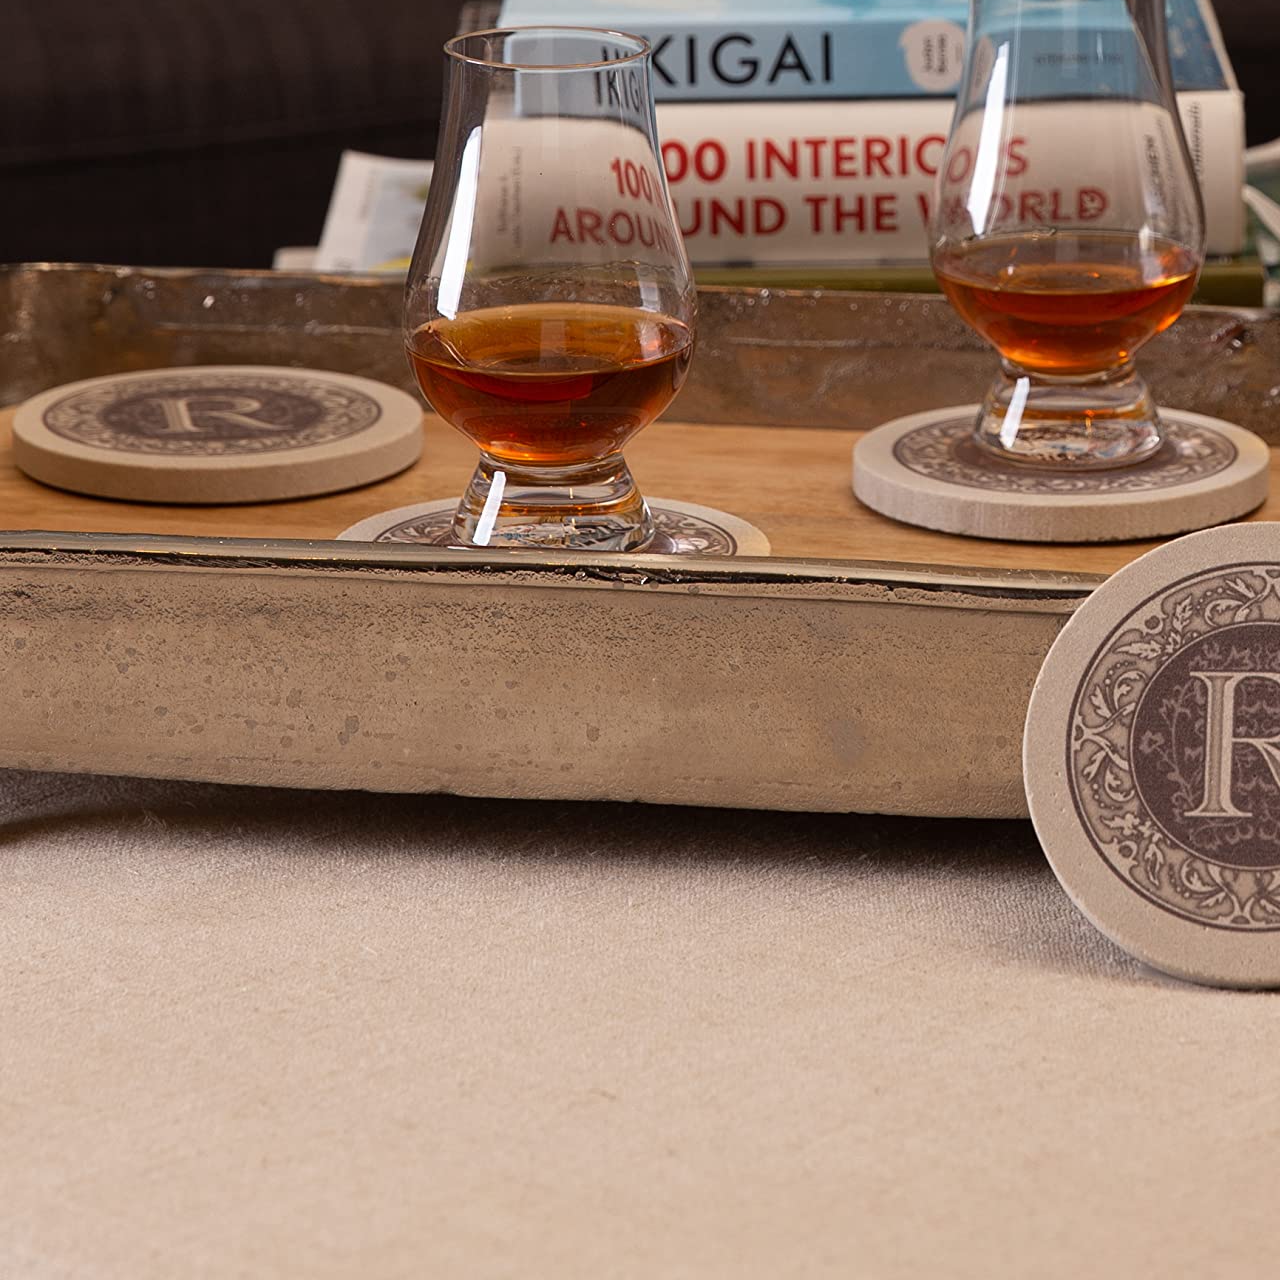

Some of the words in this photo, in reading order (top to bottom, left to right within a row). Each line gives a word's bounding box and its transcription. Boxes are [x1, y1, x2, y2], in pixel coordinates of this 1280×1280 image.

[744, 132, 1029, 181] INTERIOS
[551, 194, 788, 250] AROUND
[803, 192, 899, 235] THE
[148, 394, 294, 434] R
